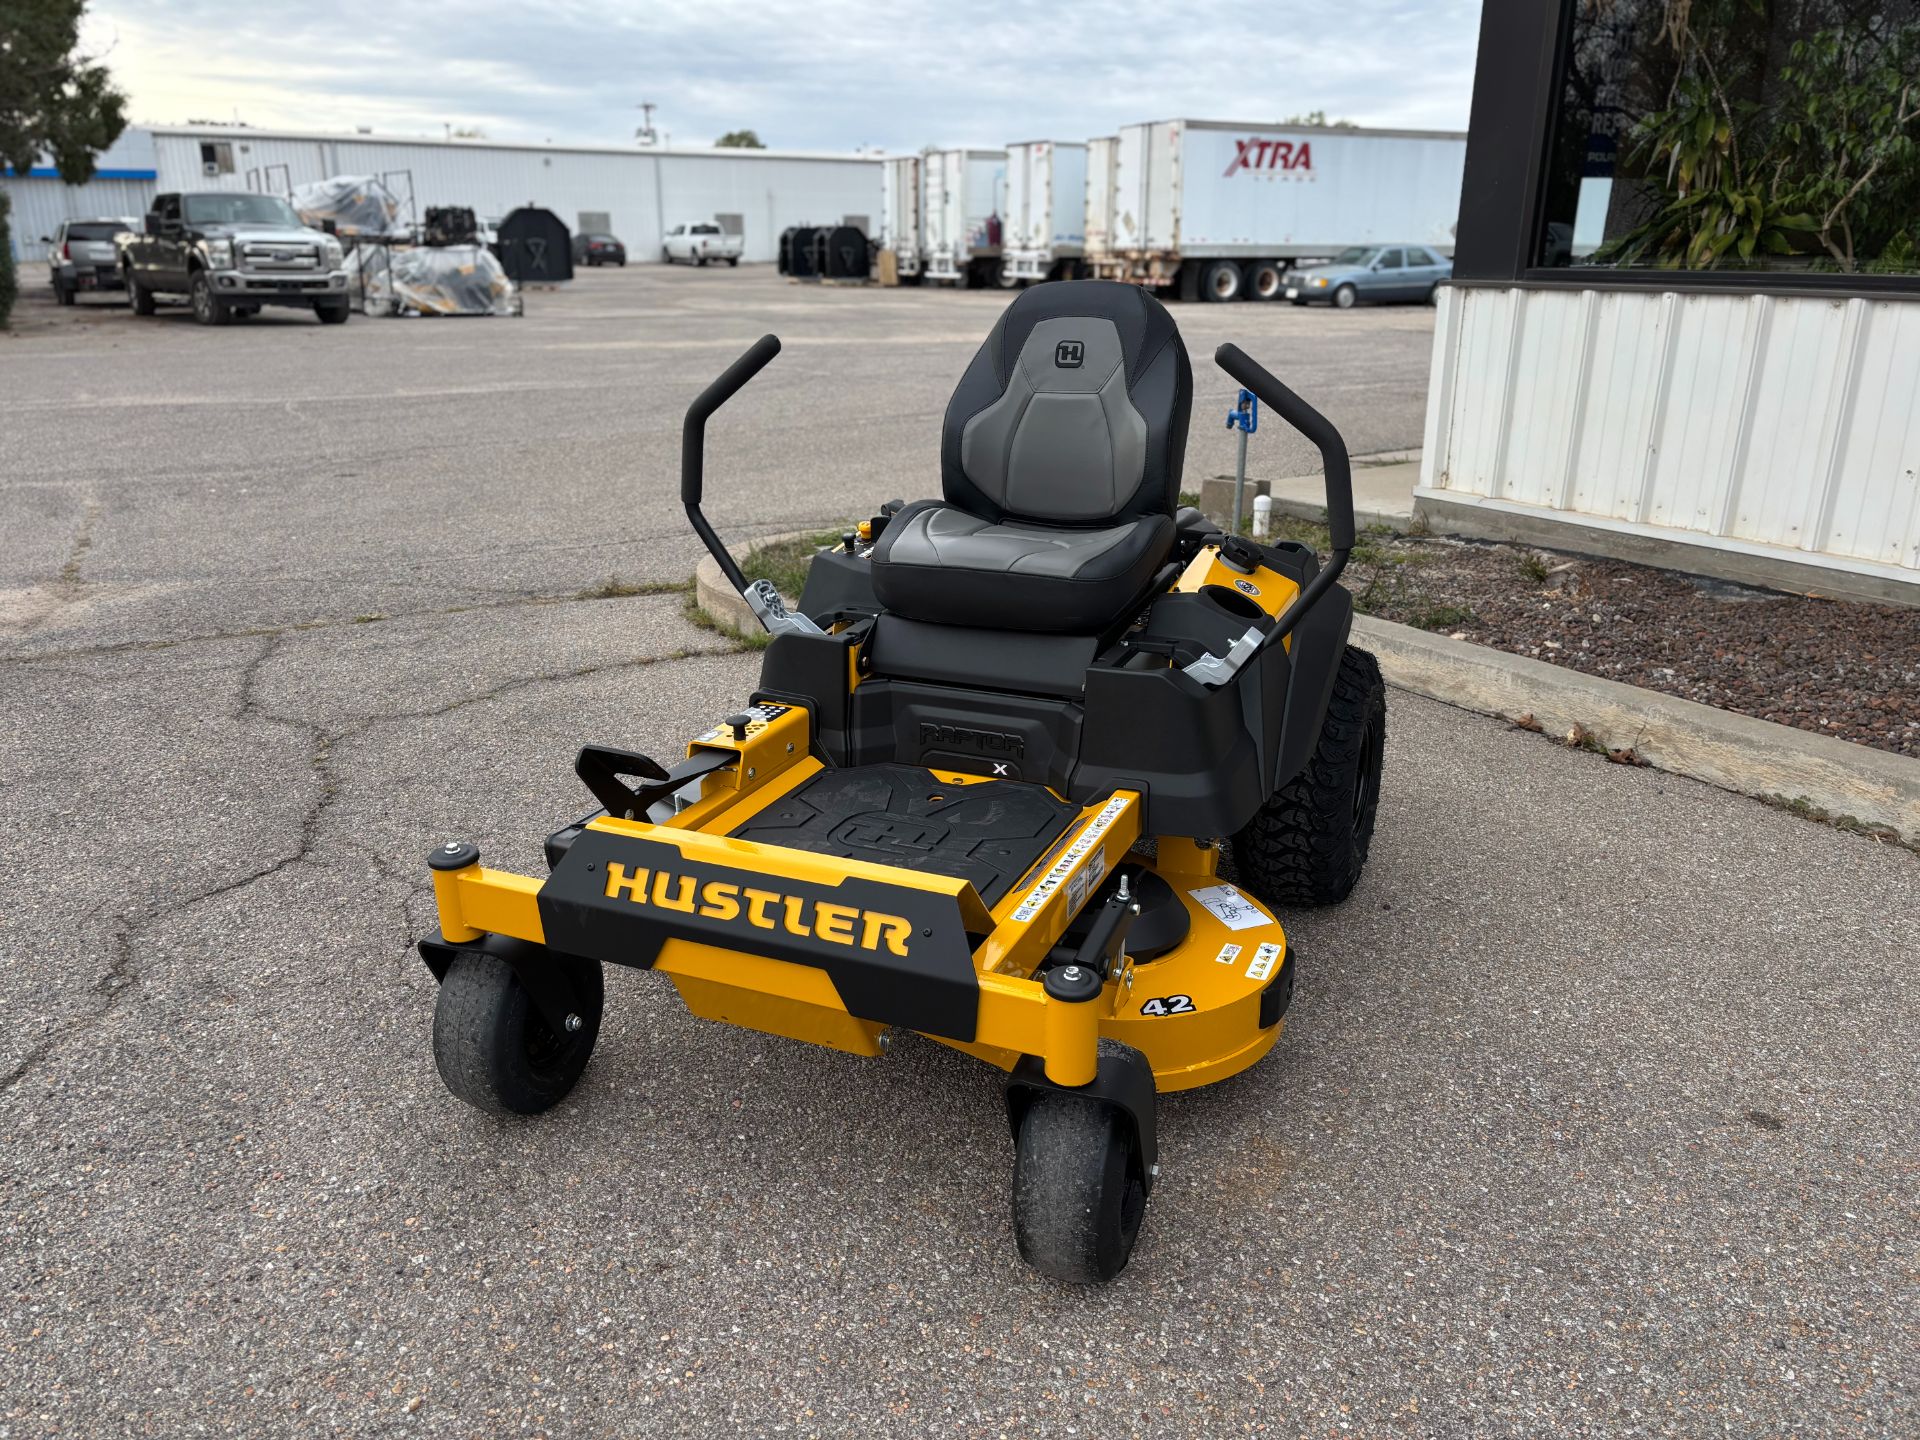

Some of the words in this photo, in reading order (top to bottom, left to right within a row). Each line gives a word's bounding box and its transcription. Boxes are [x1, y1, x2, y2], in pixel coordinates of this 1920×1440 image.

[1223, 136, 1311, 177] XTRA
[920, 722, 1024, 760] RAPTOR
[604, 861, 913, 957] HUSTLER
[1142, 994, 1194, 1016] 42
